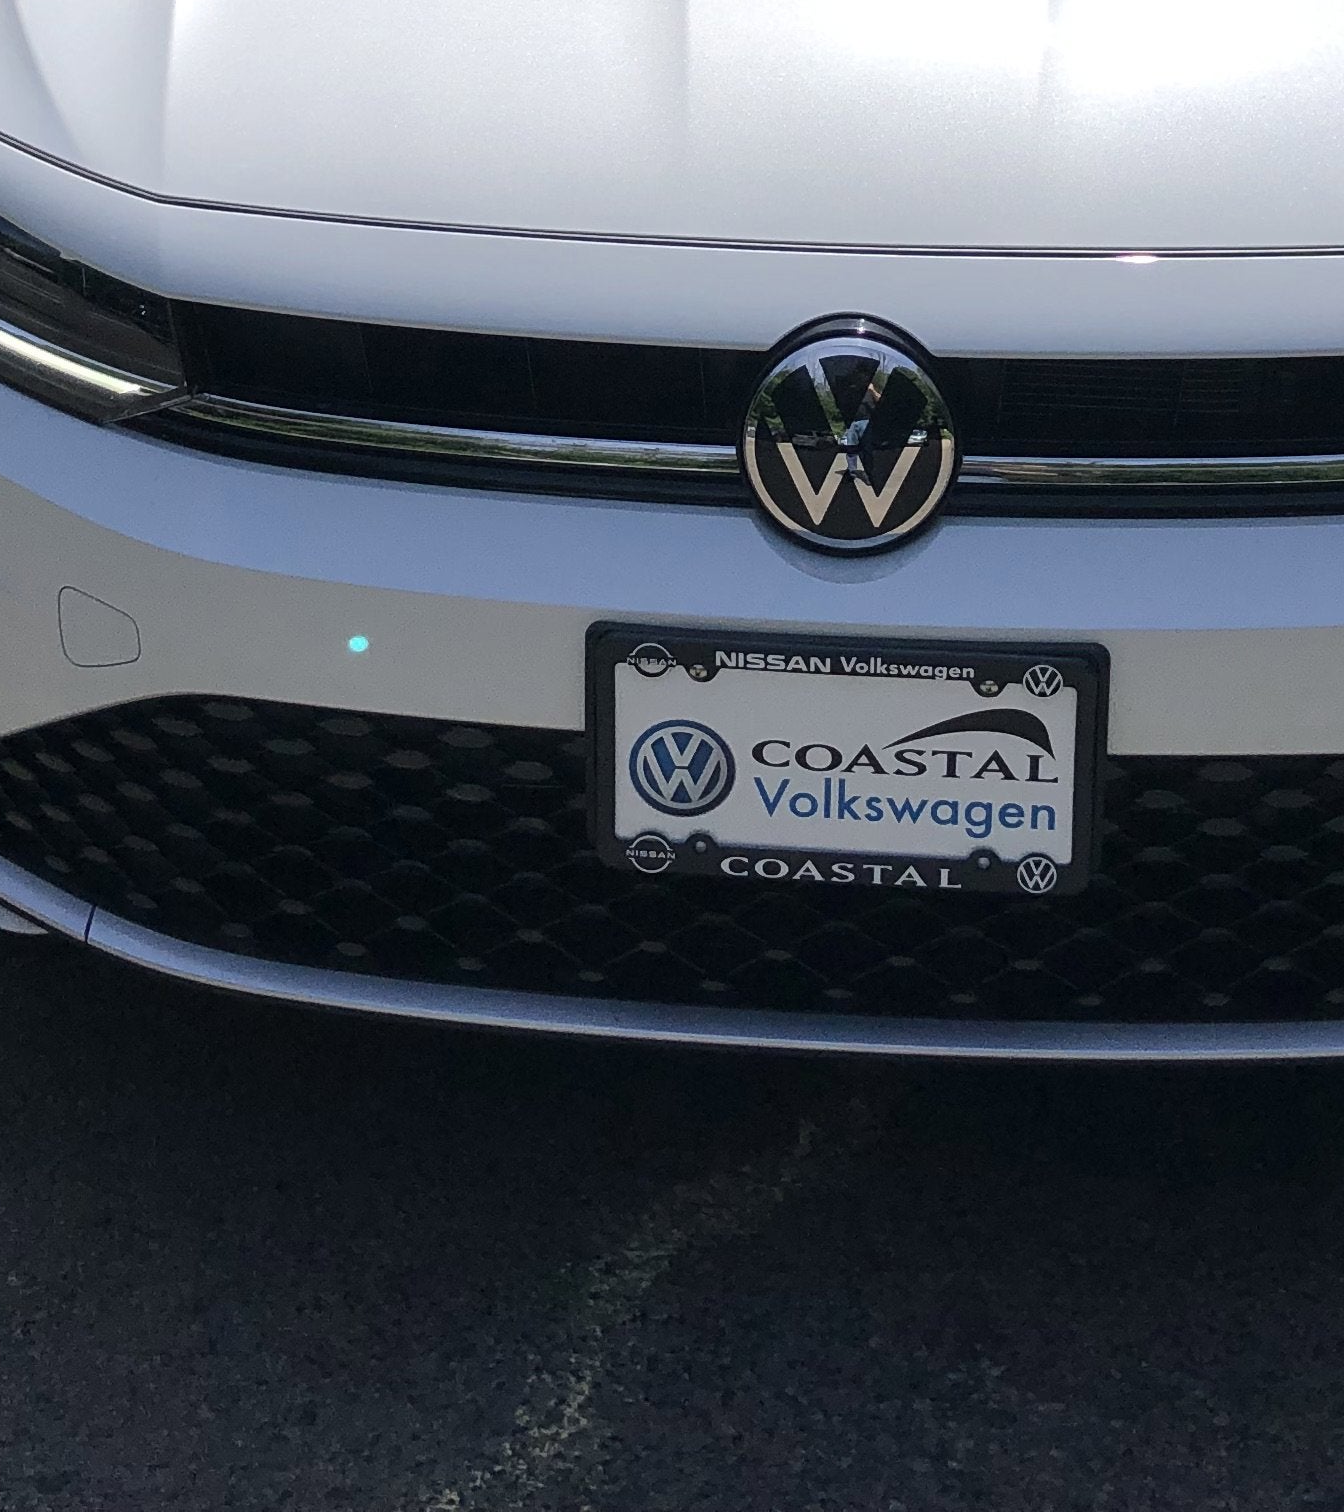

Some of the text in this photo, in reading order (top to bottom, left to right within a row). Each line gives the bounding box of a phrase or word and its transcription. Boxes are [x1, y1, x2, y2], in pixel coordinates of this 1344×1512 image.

[715, 650, 975, 681] NISSAN Volkswagen
[751, 739, 1059, 784] COASTAL
[753, 777, 1057, 839] Volkswagen
[625, 849, 676, 860] NISSAN
[720, 855, 962, 889] COASTAL
